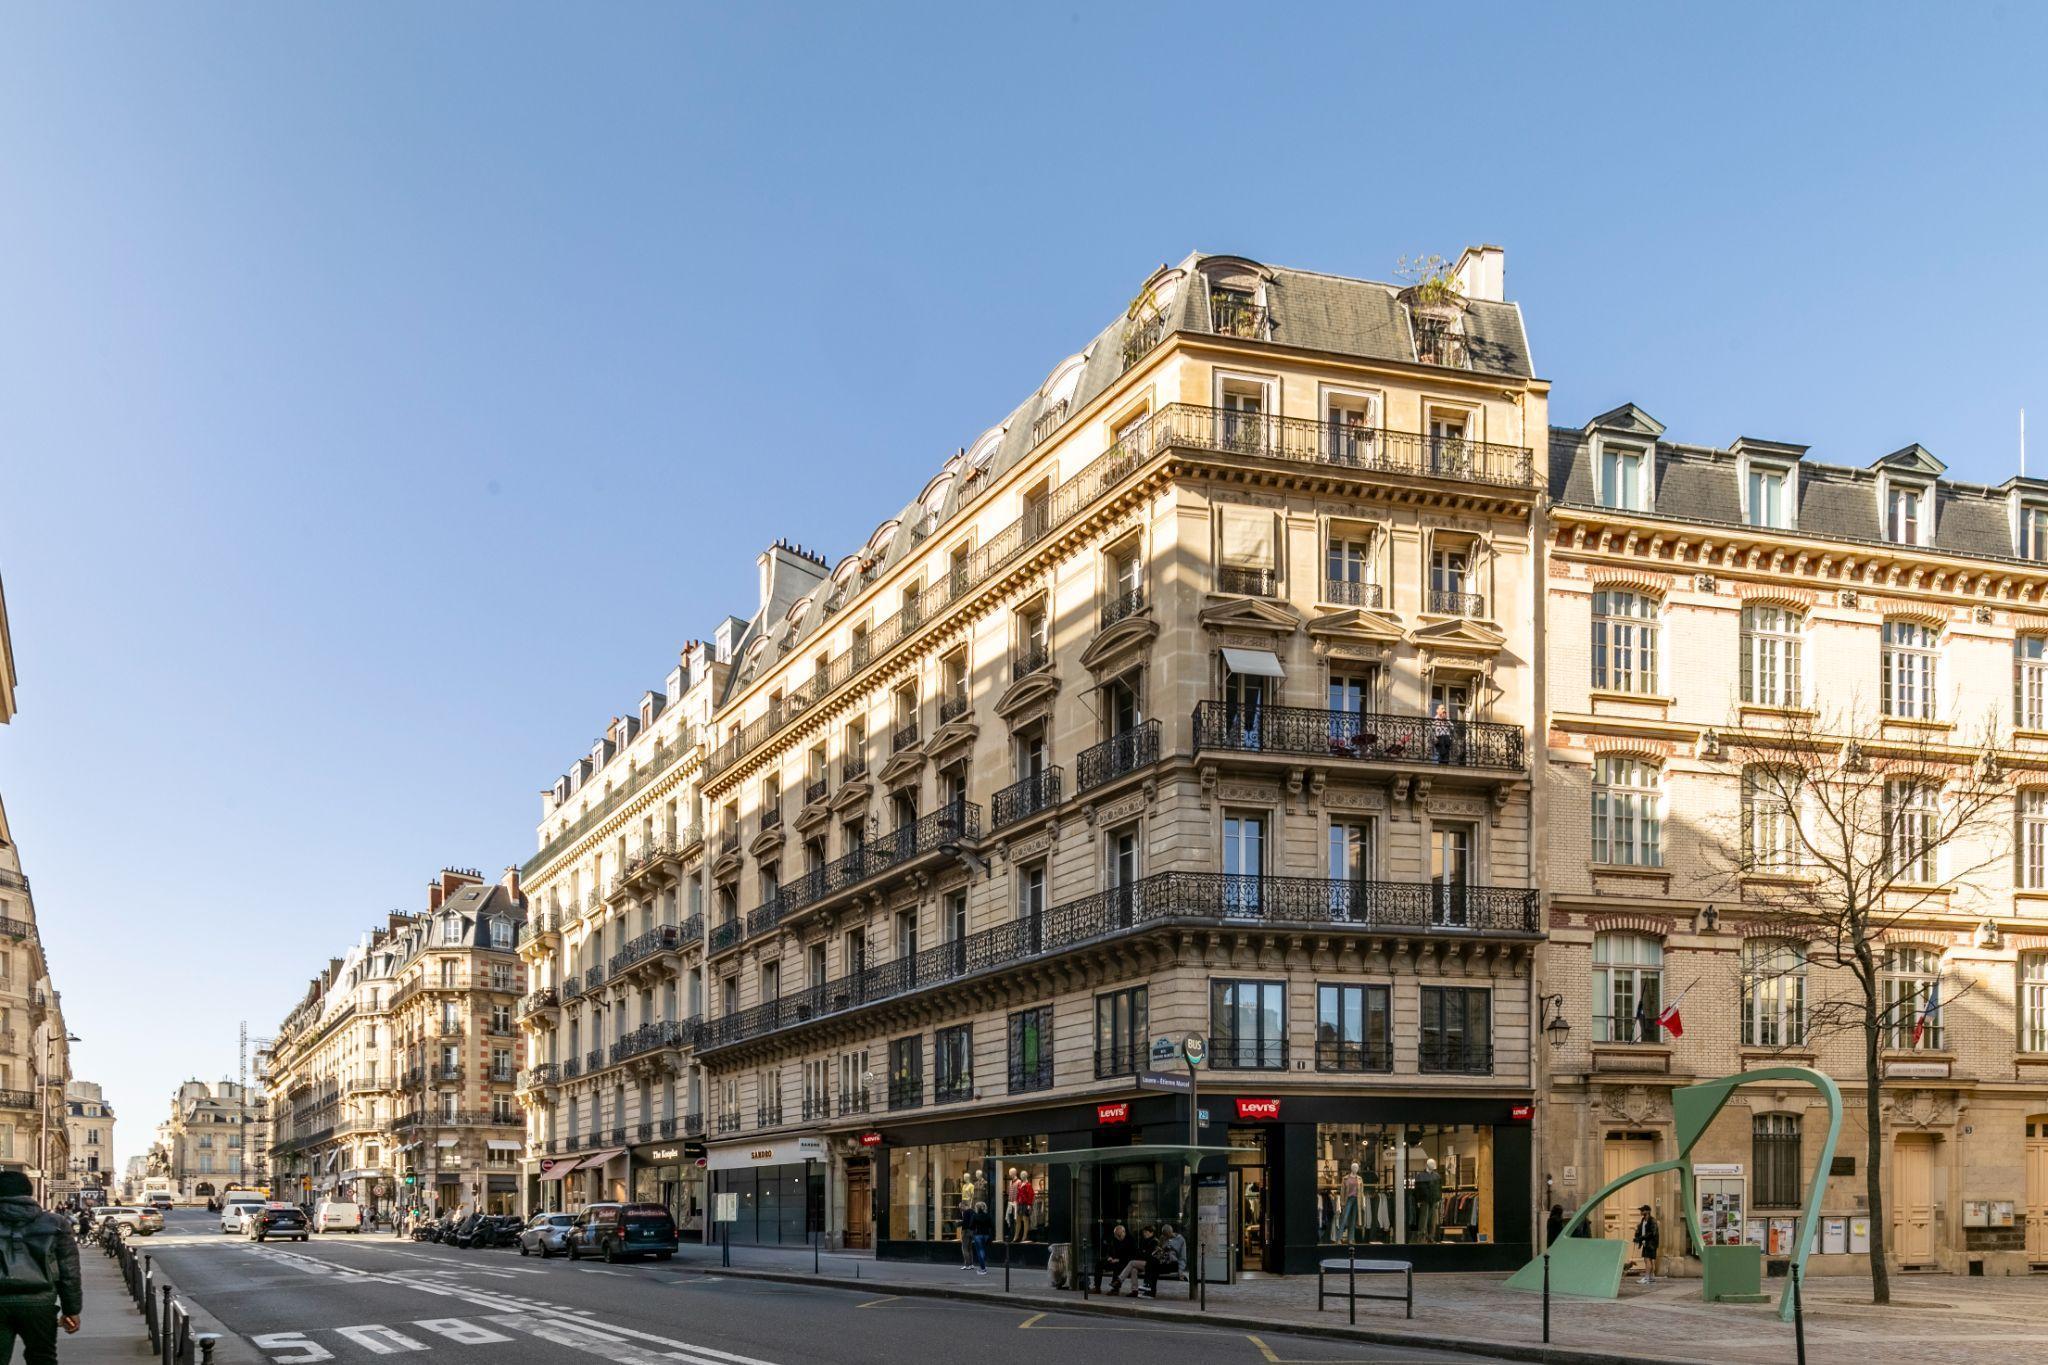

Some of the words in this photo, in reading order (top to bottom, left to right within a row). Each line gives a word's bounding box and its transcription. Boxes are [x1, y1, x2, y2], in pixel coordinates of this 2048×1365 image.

[1187, 1039, 1202, 1050] BUS
[751, 1150, 772, 1160] SANDRO
[251, 1318, 517, 1364] BUS
